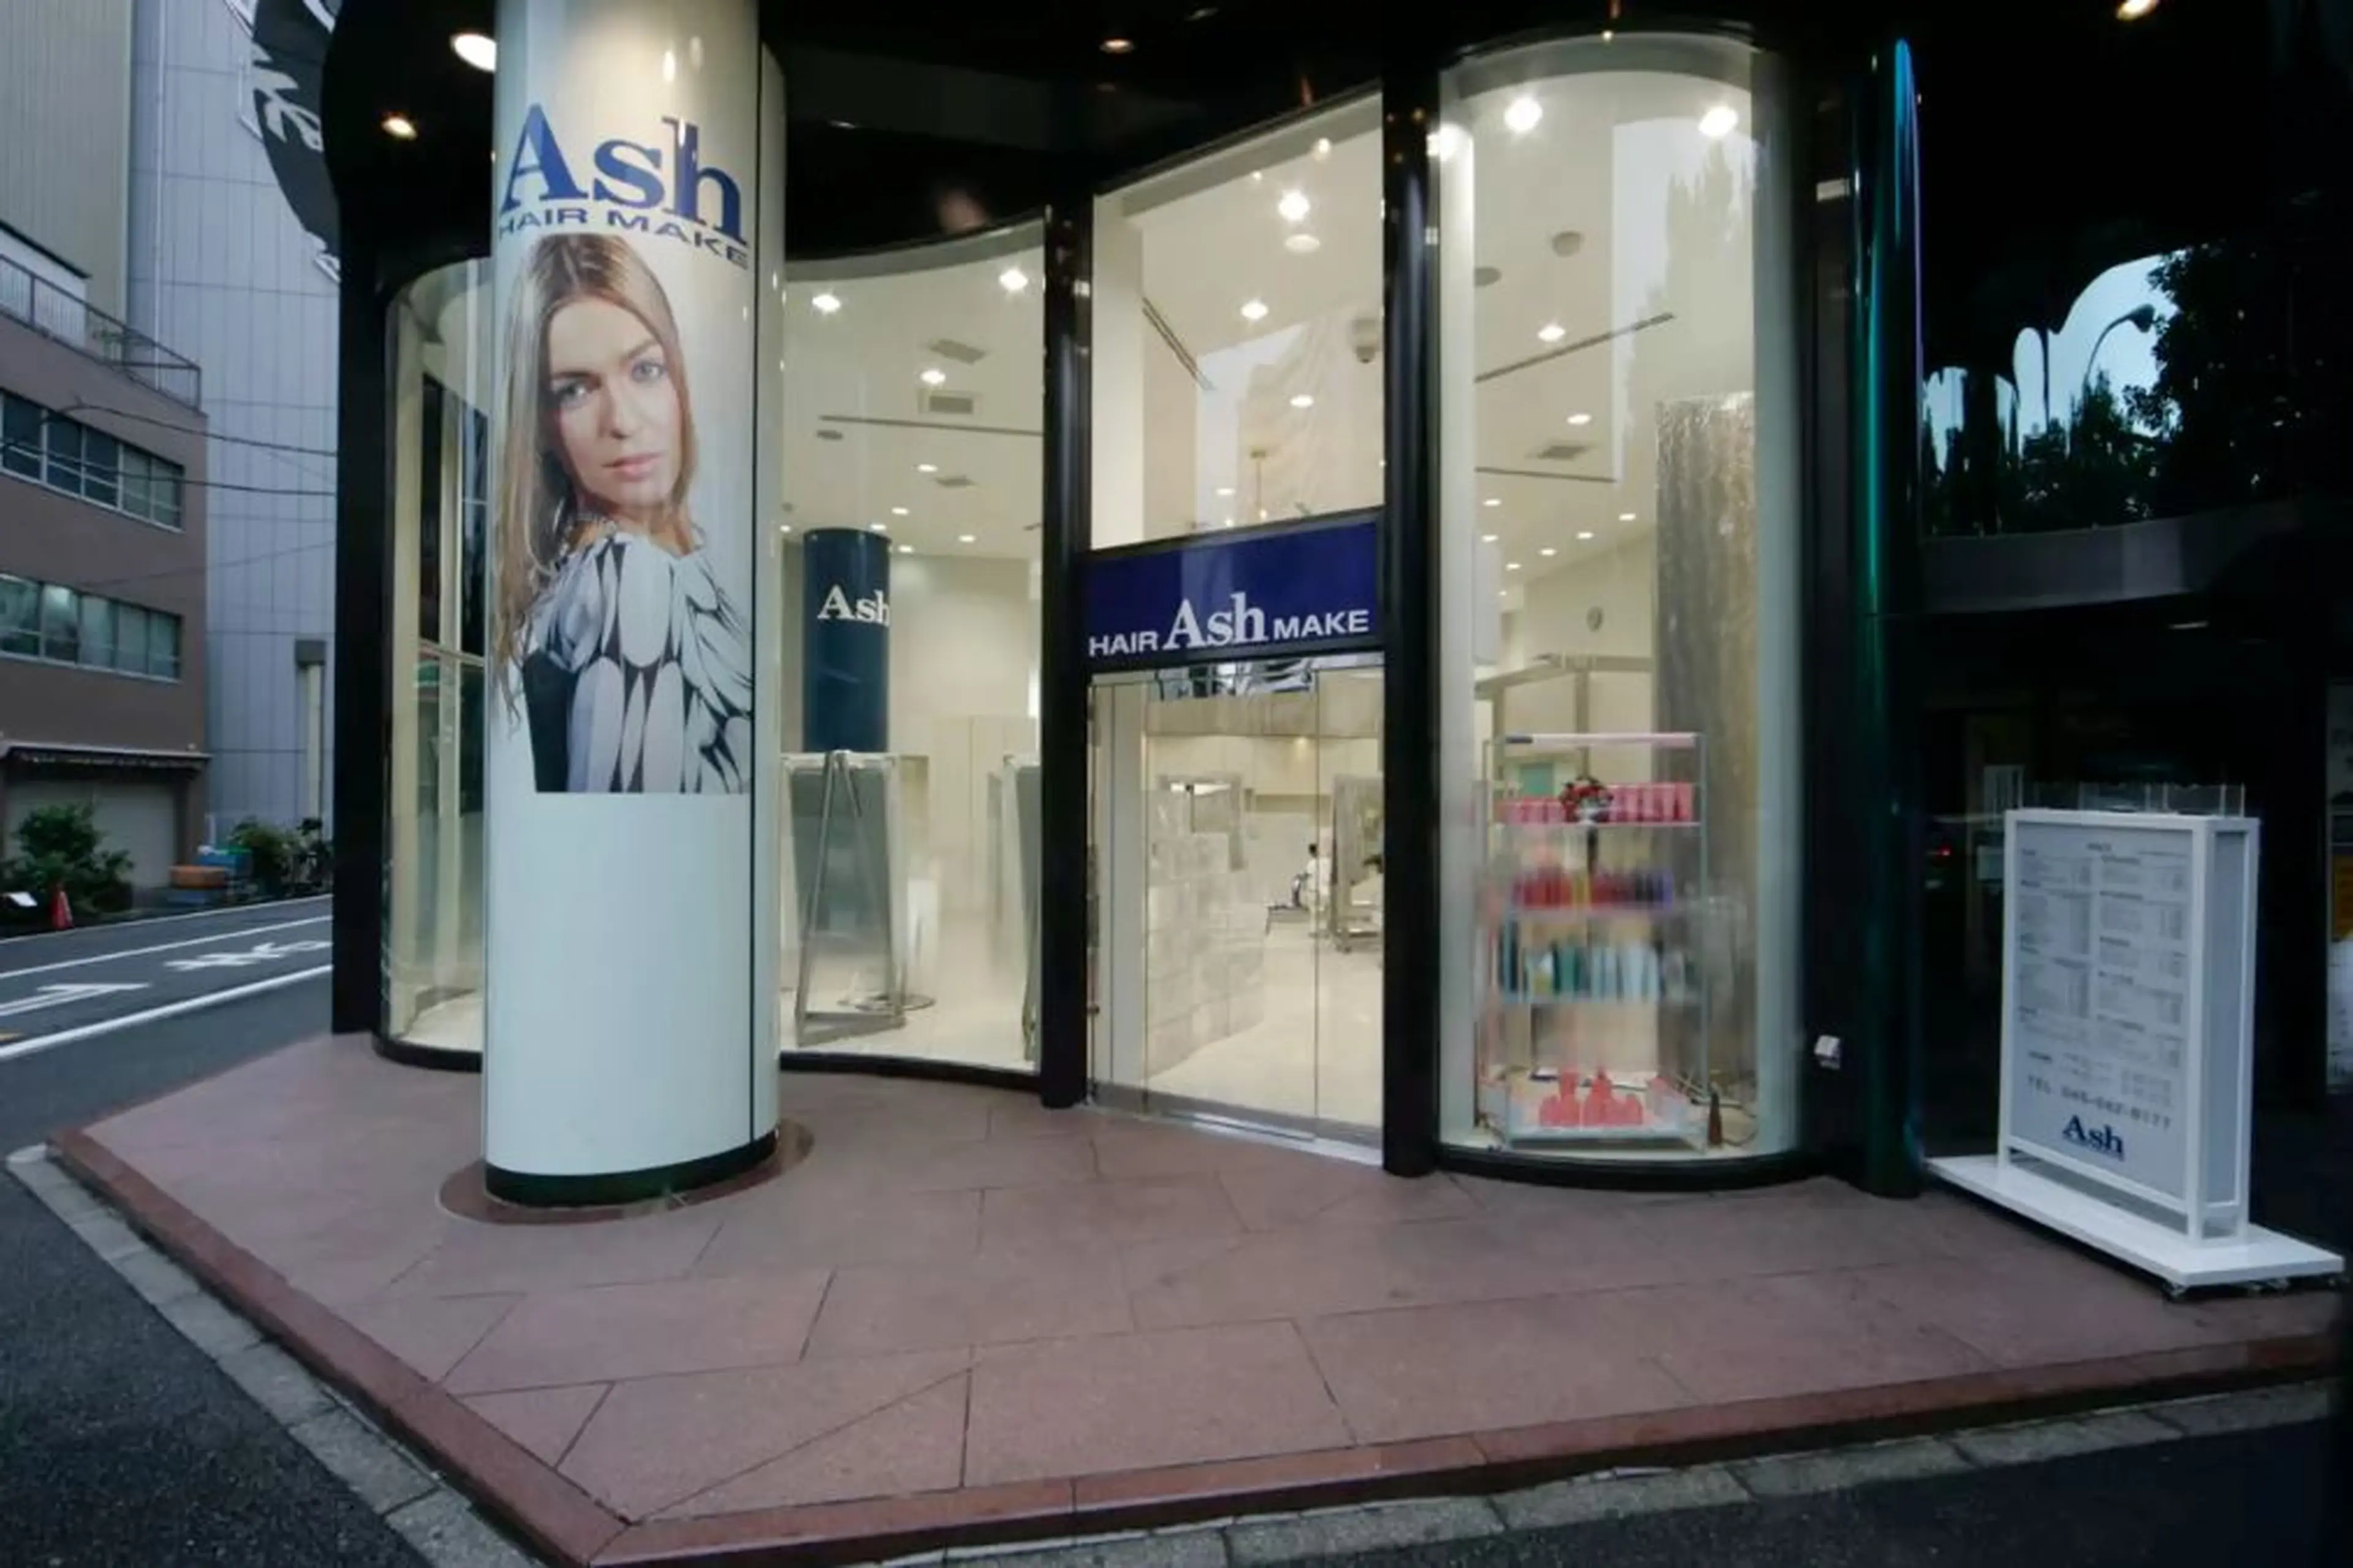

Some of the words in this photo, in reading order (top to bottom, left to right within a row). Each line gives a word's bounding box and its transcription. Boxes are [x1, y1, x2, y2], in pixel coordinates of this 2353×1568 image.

[500, 102, 749, 248] Ash
[499, 207, 588, 241] HAIR
[607, 210, 749, 270] MAKE
[817, 583, 890, 627] Ash
[1088, 631, 1159, 657] HAIR
[1162, 592, 1268, 650] Ash
[1273, 610, 1370, 640] MAKE
[2063, 1114, 2125, 1156] Ash
